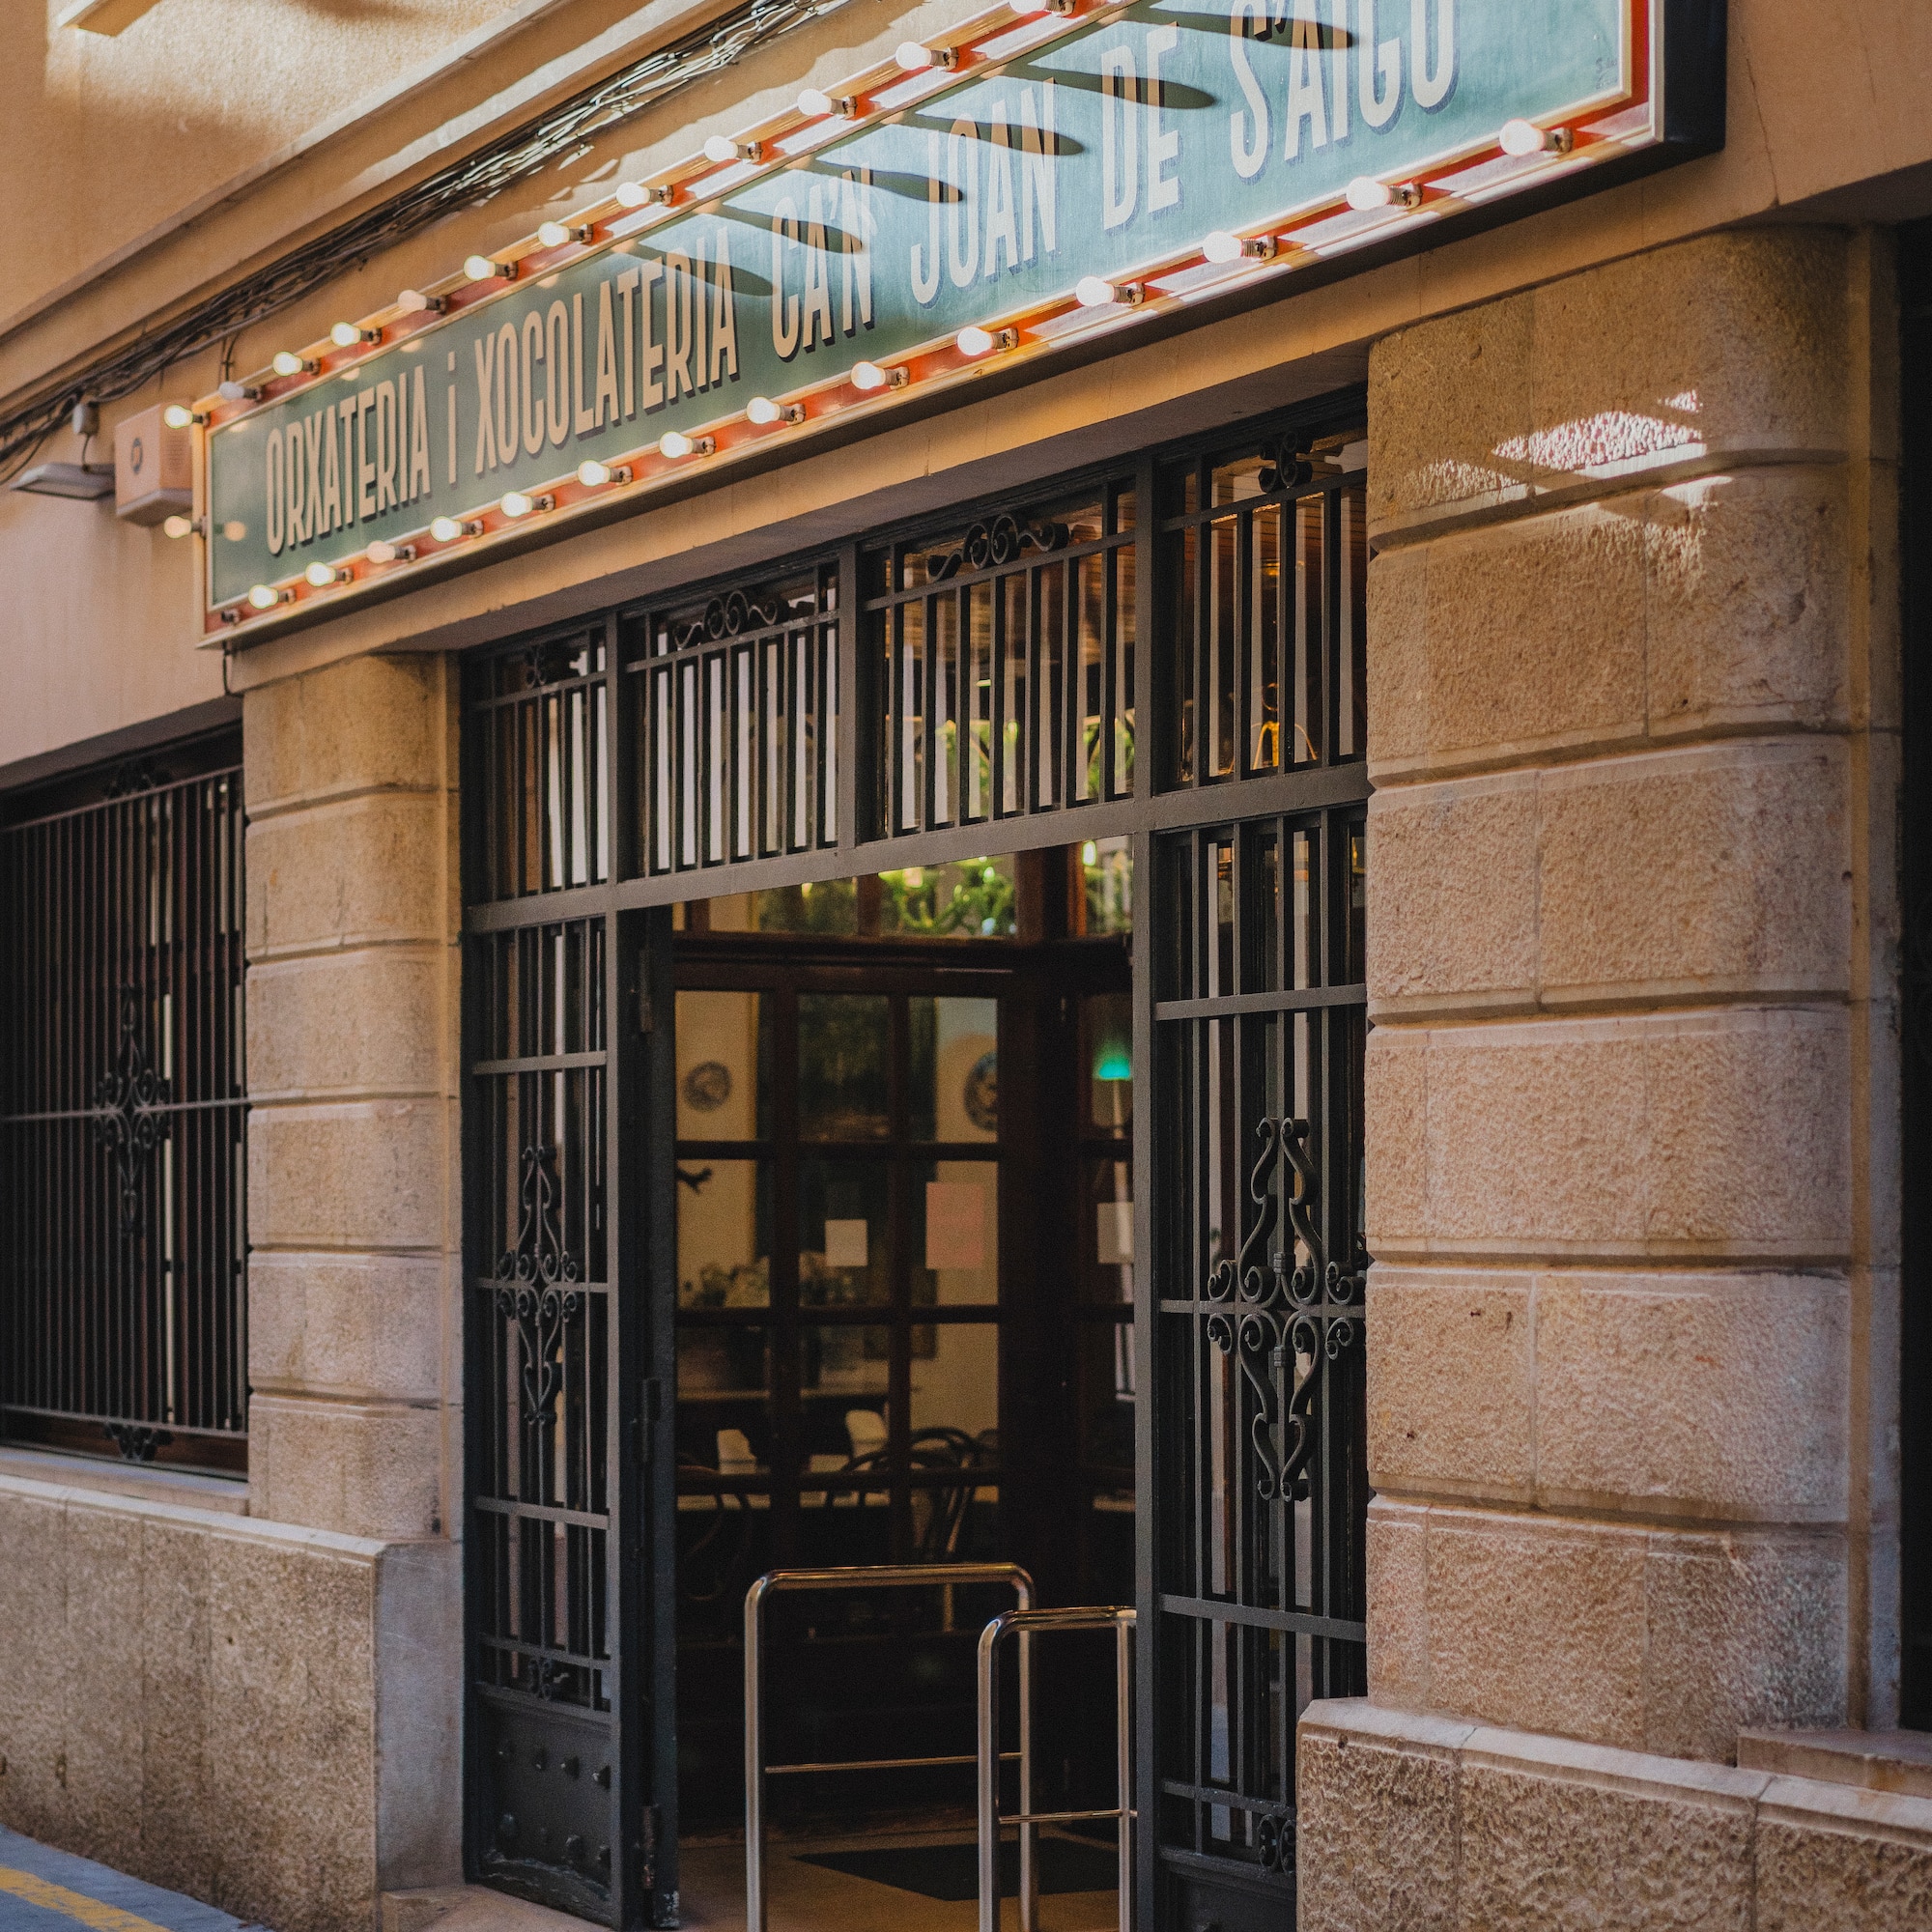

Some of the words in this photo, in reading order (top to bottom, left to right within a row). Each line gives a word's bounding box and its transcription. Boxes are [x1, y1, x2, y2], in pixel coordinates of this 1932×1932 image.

[266, 365, 432, 556] ORXATERIA
[475, 227, 740, 476] XOCOLATERIA
[772, 161, 874, 361] CA'N
[911, 77, 1060, 308] JOAN
[1101, 21, 1181, 233] DE
